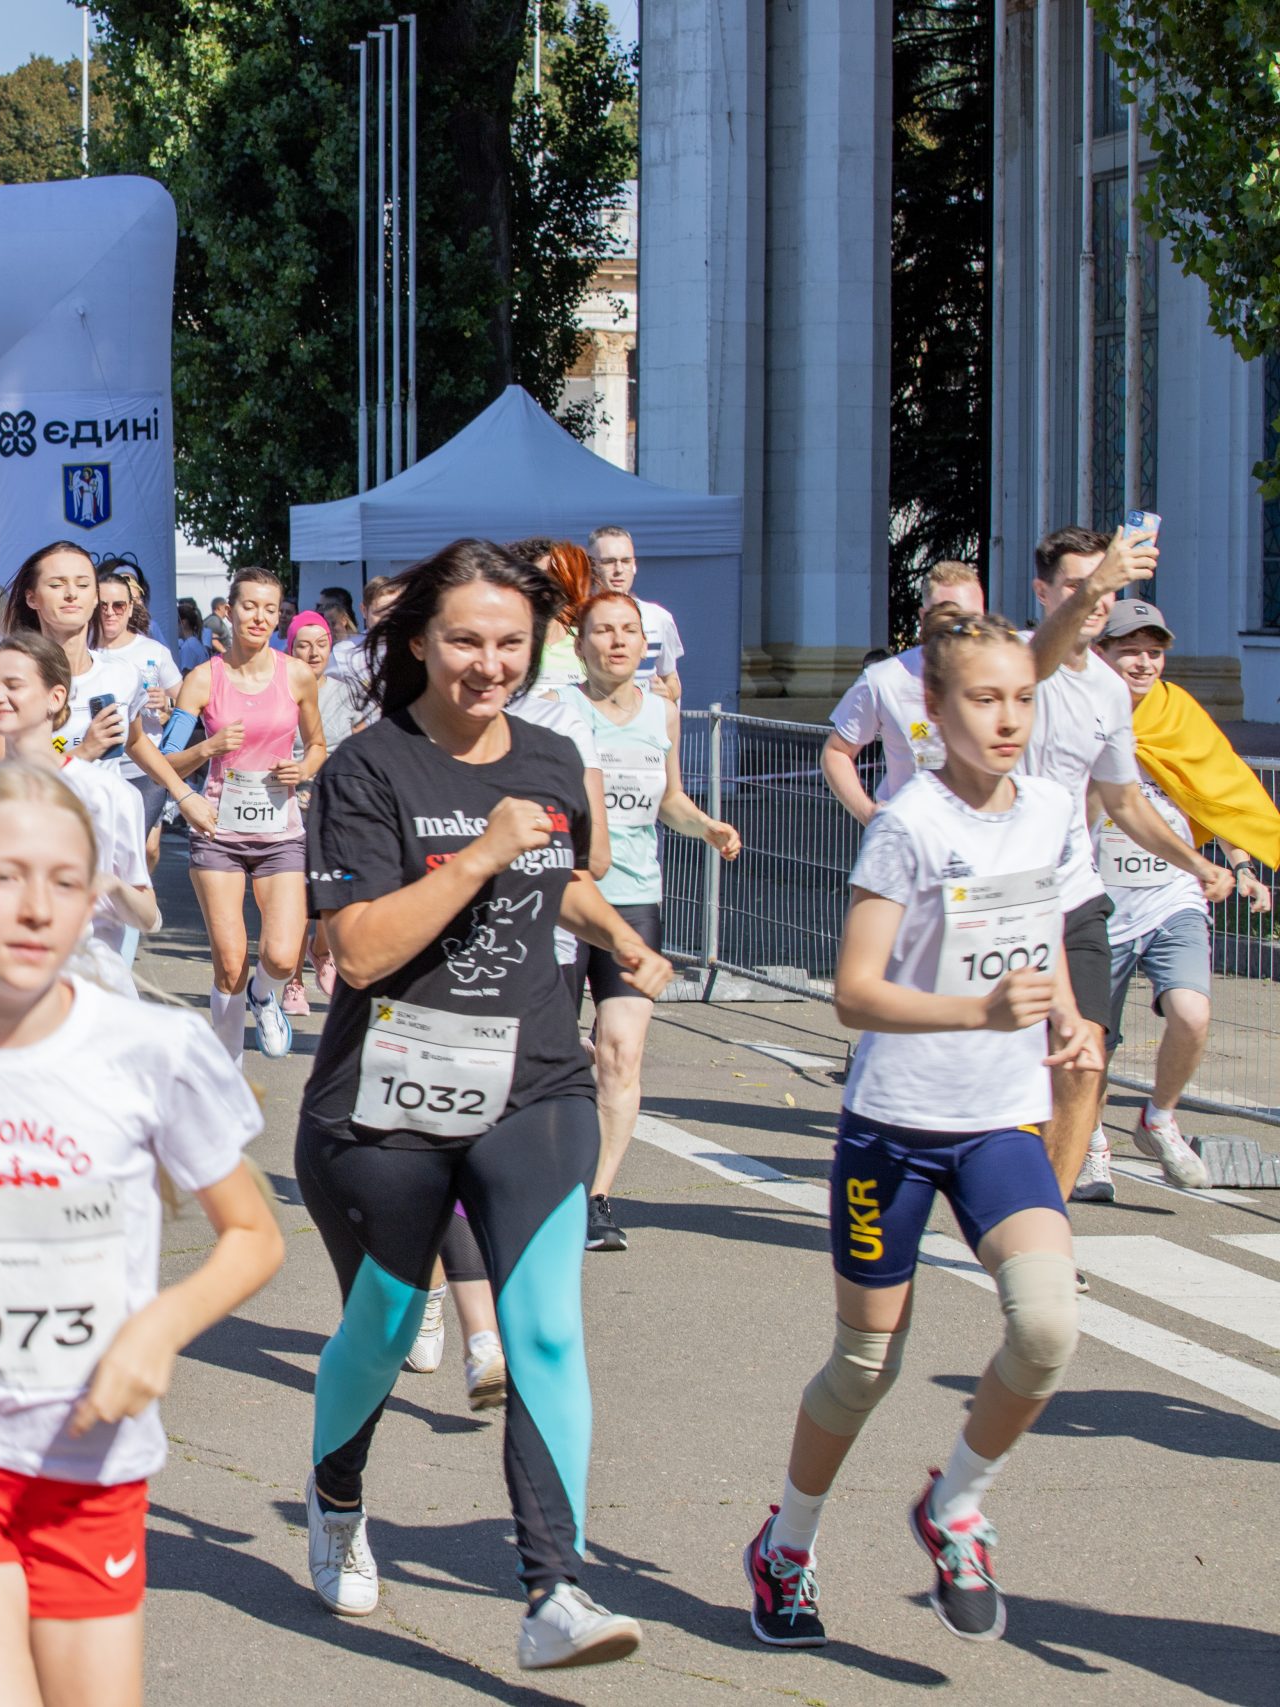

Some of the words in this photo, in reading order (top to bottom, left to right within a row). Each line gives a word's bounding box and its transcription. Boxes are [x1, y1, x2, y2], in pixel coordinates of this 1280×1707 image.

[43, 407, 159, 449] єдині
[233, 806, 274, 821] 1011
[604, 792, 652, 811] 004
[412, 810, 489, 838] make
[509, 840, 575, 876] again
[1113, 856, 1169, 873] 1018
[961, 943, 1050, 981] 1002
[380, 1076, 486, 1115] 1032
[847, 1177, 884, 1260] UKR
